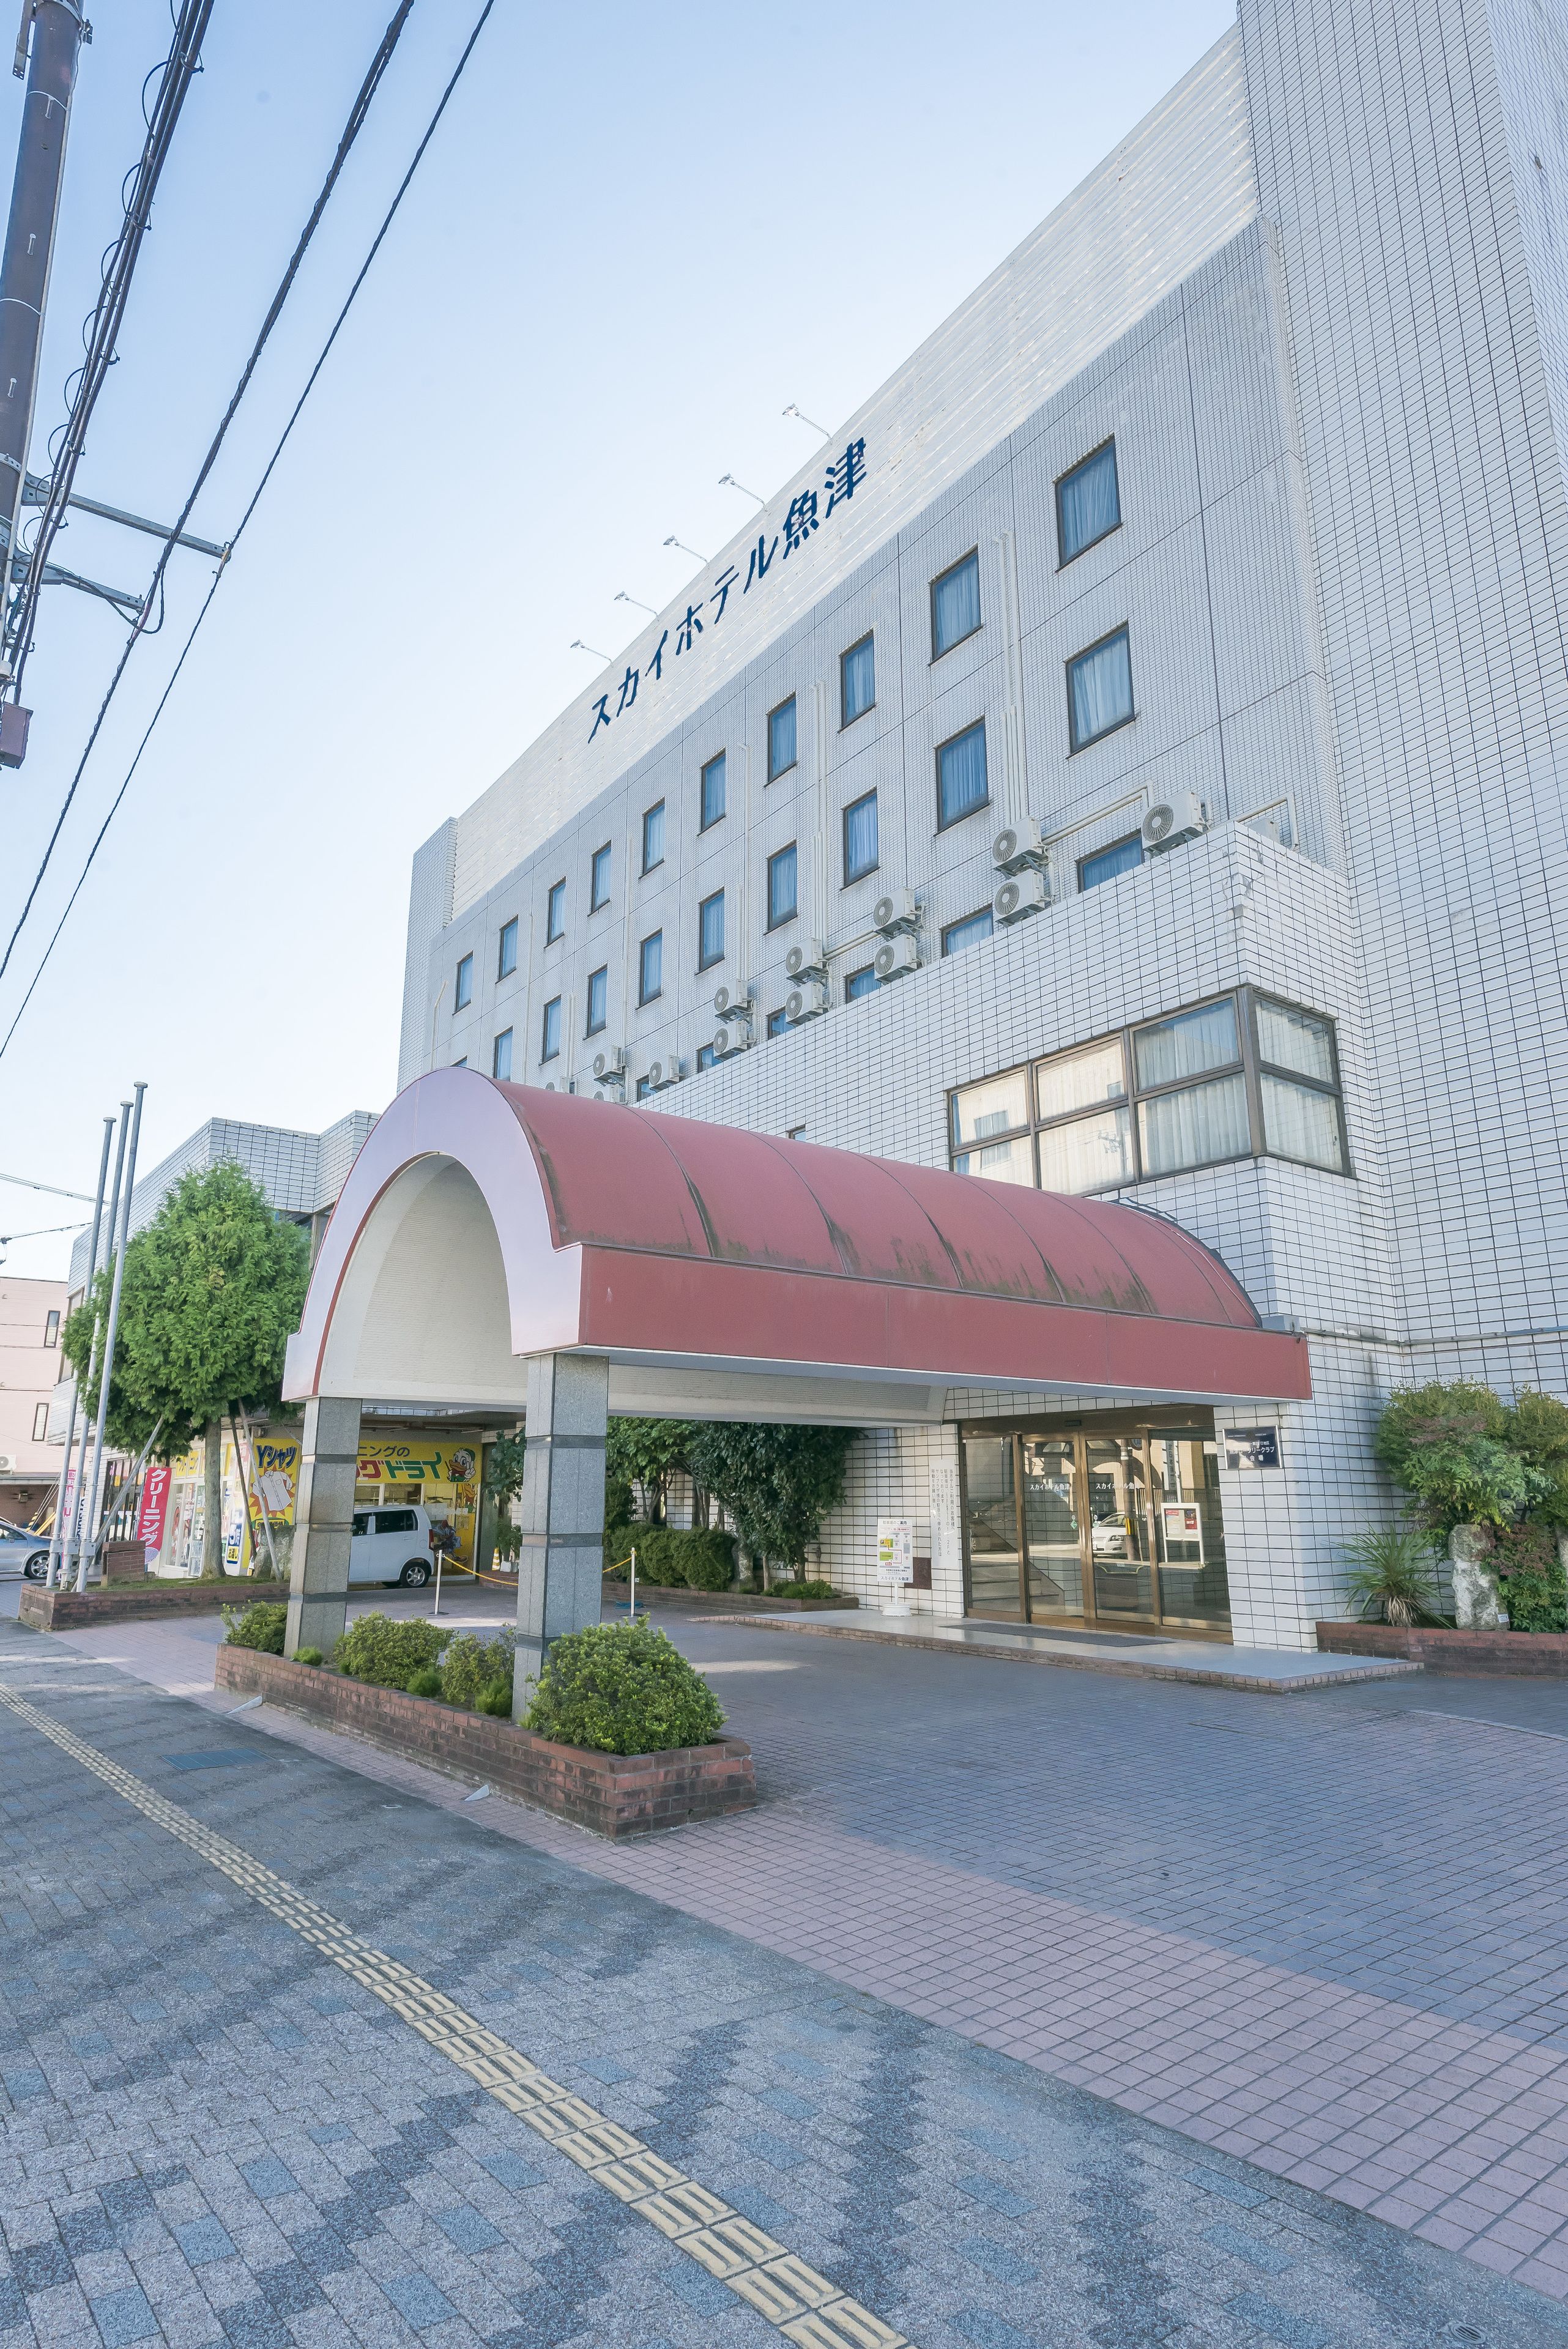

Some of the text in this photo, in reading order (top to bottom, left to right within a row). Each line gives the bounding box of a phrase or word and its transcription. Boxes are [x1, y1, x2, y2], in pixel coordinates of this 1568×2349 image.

[588, 437, 867, 743] スカイホテル魚津
[256, 1445, 297, 1469] Yシャツ
[358, 1445, 410, 1457] ニングの
[356, 1452, 442, 1479] グドライ
[140, 1469, 167, 1546] クリーニング
